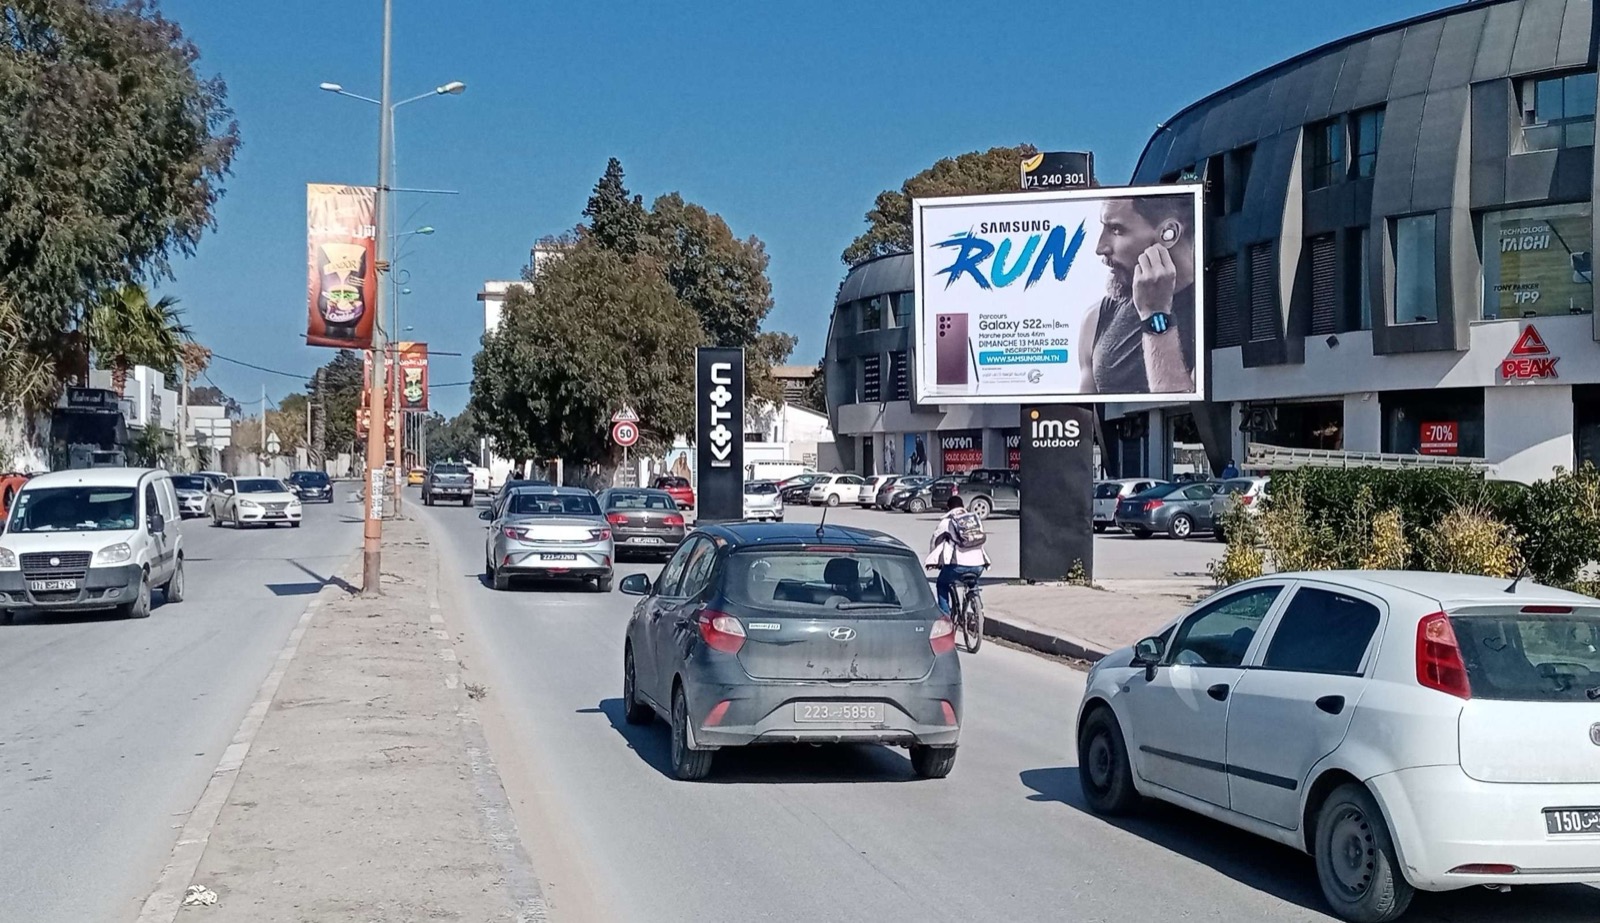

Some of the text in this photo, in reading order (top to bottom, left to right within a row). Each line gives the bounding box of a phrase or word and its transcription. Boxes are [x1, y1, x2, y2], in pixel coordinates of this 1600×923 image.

[1026, 173, 1085, 186] 71 240 301
[980, 219, 1050, 234] SAMSUNG
[1499, 225, 1550, 236] TECHNOLOGIE
[930, 217, 1087, 292] RUN
[1493, 282, 1540, 292] TONY PARKER
[1513, 291, 1540, 304] TP9
[978, 320, 1020, 332] Galaxy
[978, 339, 1018, 348] DIMANCHE
[1027, 339, 1049, 347] MARS
[1050, 338, 1069, 346] 2022
[1502, 356, 1561, 379] PEAK
[1030, 409, 1080, 439] ims
[1238, 405, 1278, 432] ZEN
[620, 429, 632, 439] 50
[1426, 425, 1453, 441] -70%
[1032, 438, 1080, 448] outdoor
[944, 452, 960, 461] SOLDE
[960, 452, 976, 461] SOLDE
[804, 705, 829, 718] 223
[843, 705, 876, 719] 5856
[1554, 811, 1582, 831] 150
